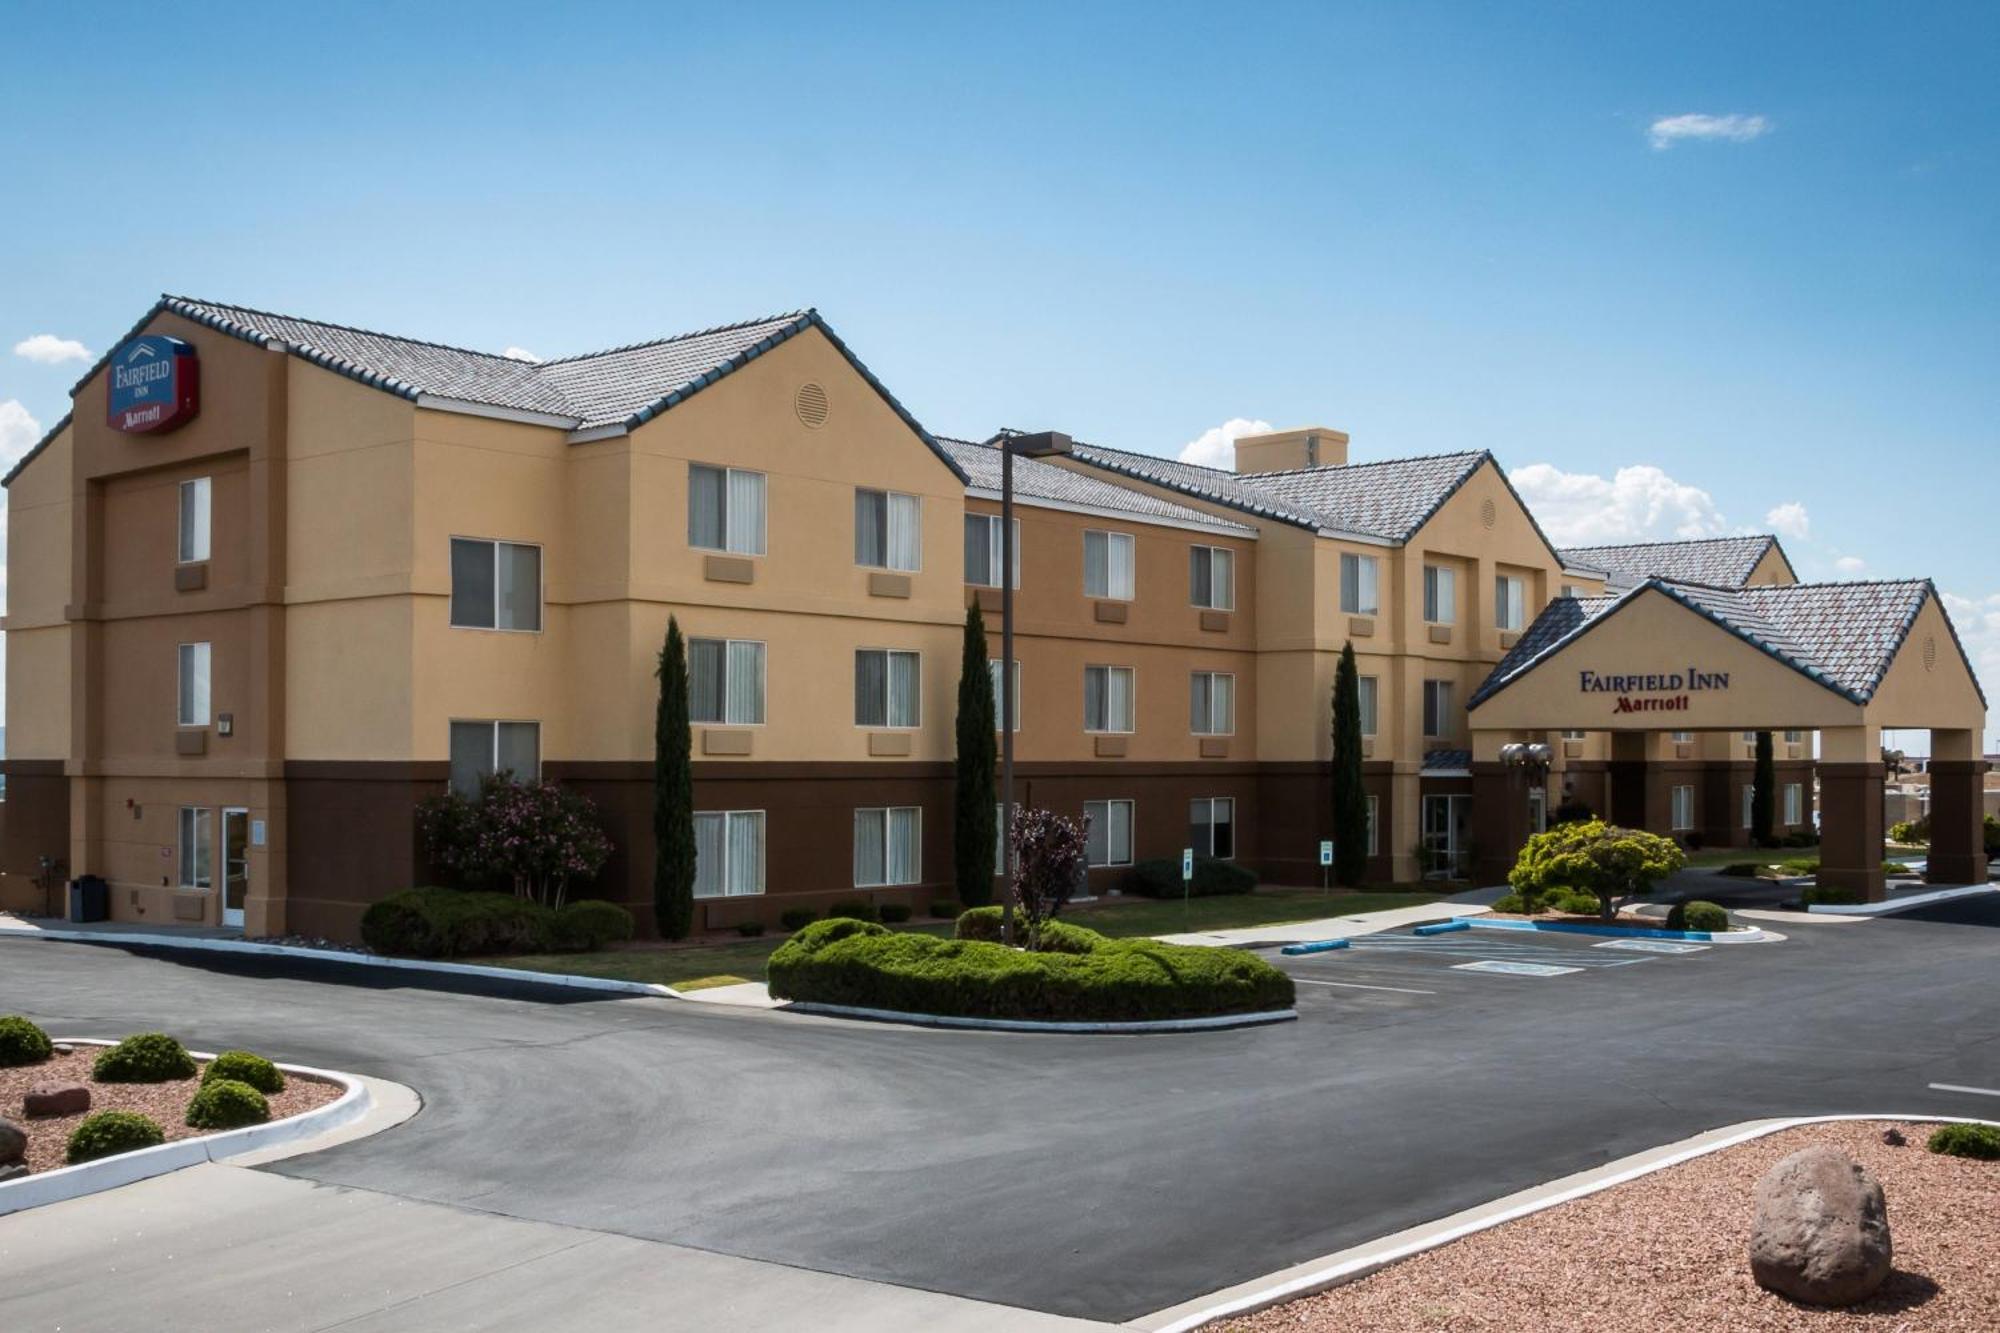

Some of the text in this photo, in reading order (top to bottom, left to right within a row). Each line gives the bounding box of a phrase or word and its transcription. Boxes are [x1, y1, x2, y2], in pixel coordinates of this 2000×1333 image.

[116, 360, 169, 388] FAIRFIELD
[134, 385, 149, 398] INN
[123, 405, 160, 430] Marriott
[1580, 668, 1730, 693] FAIRFIELD INN
[1613, 695, 1689, 714] Marriott
